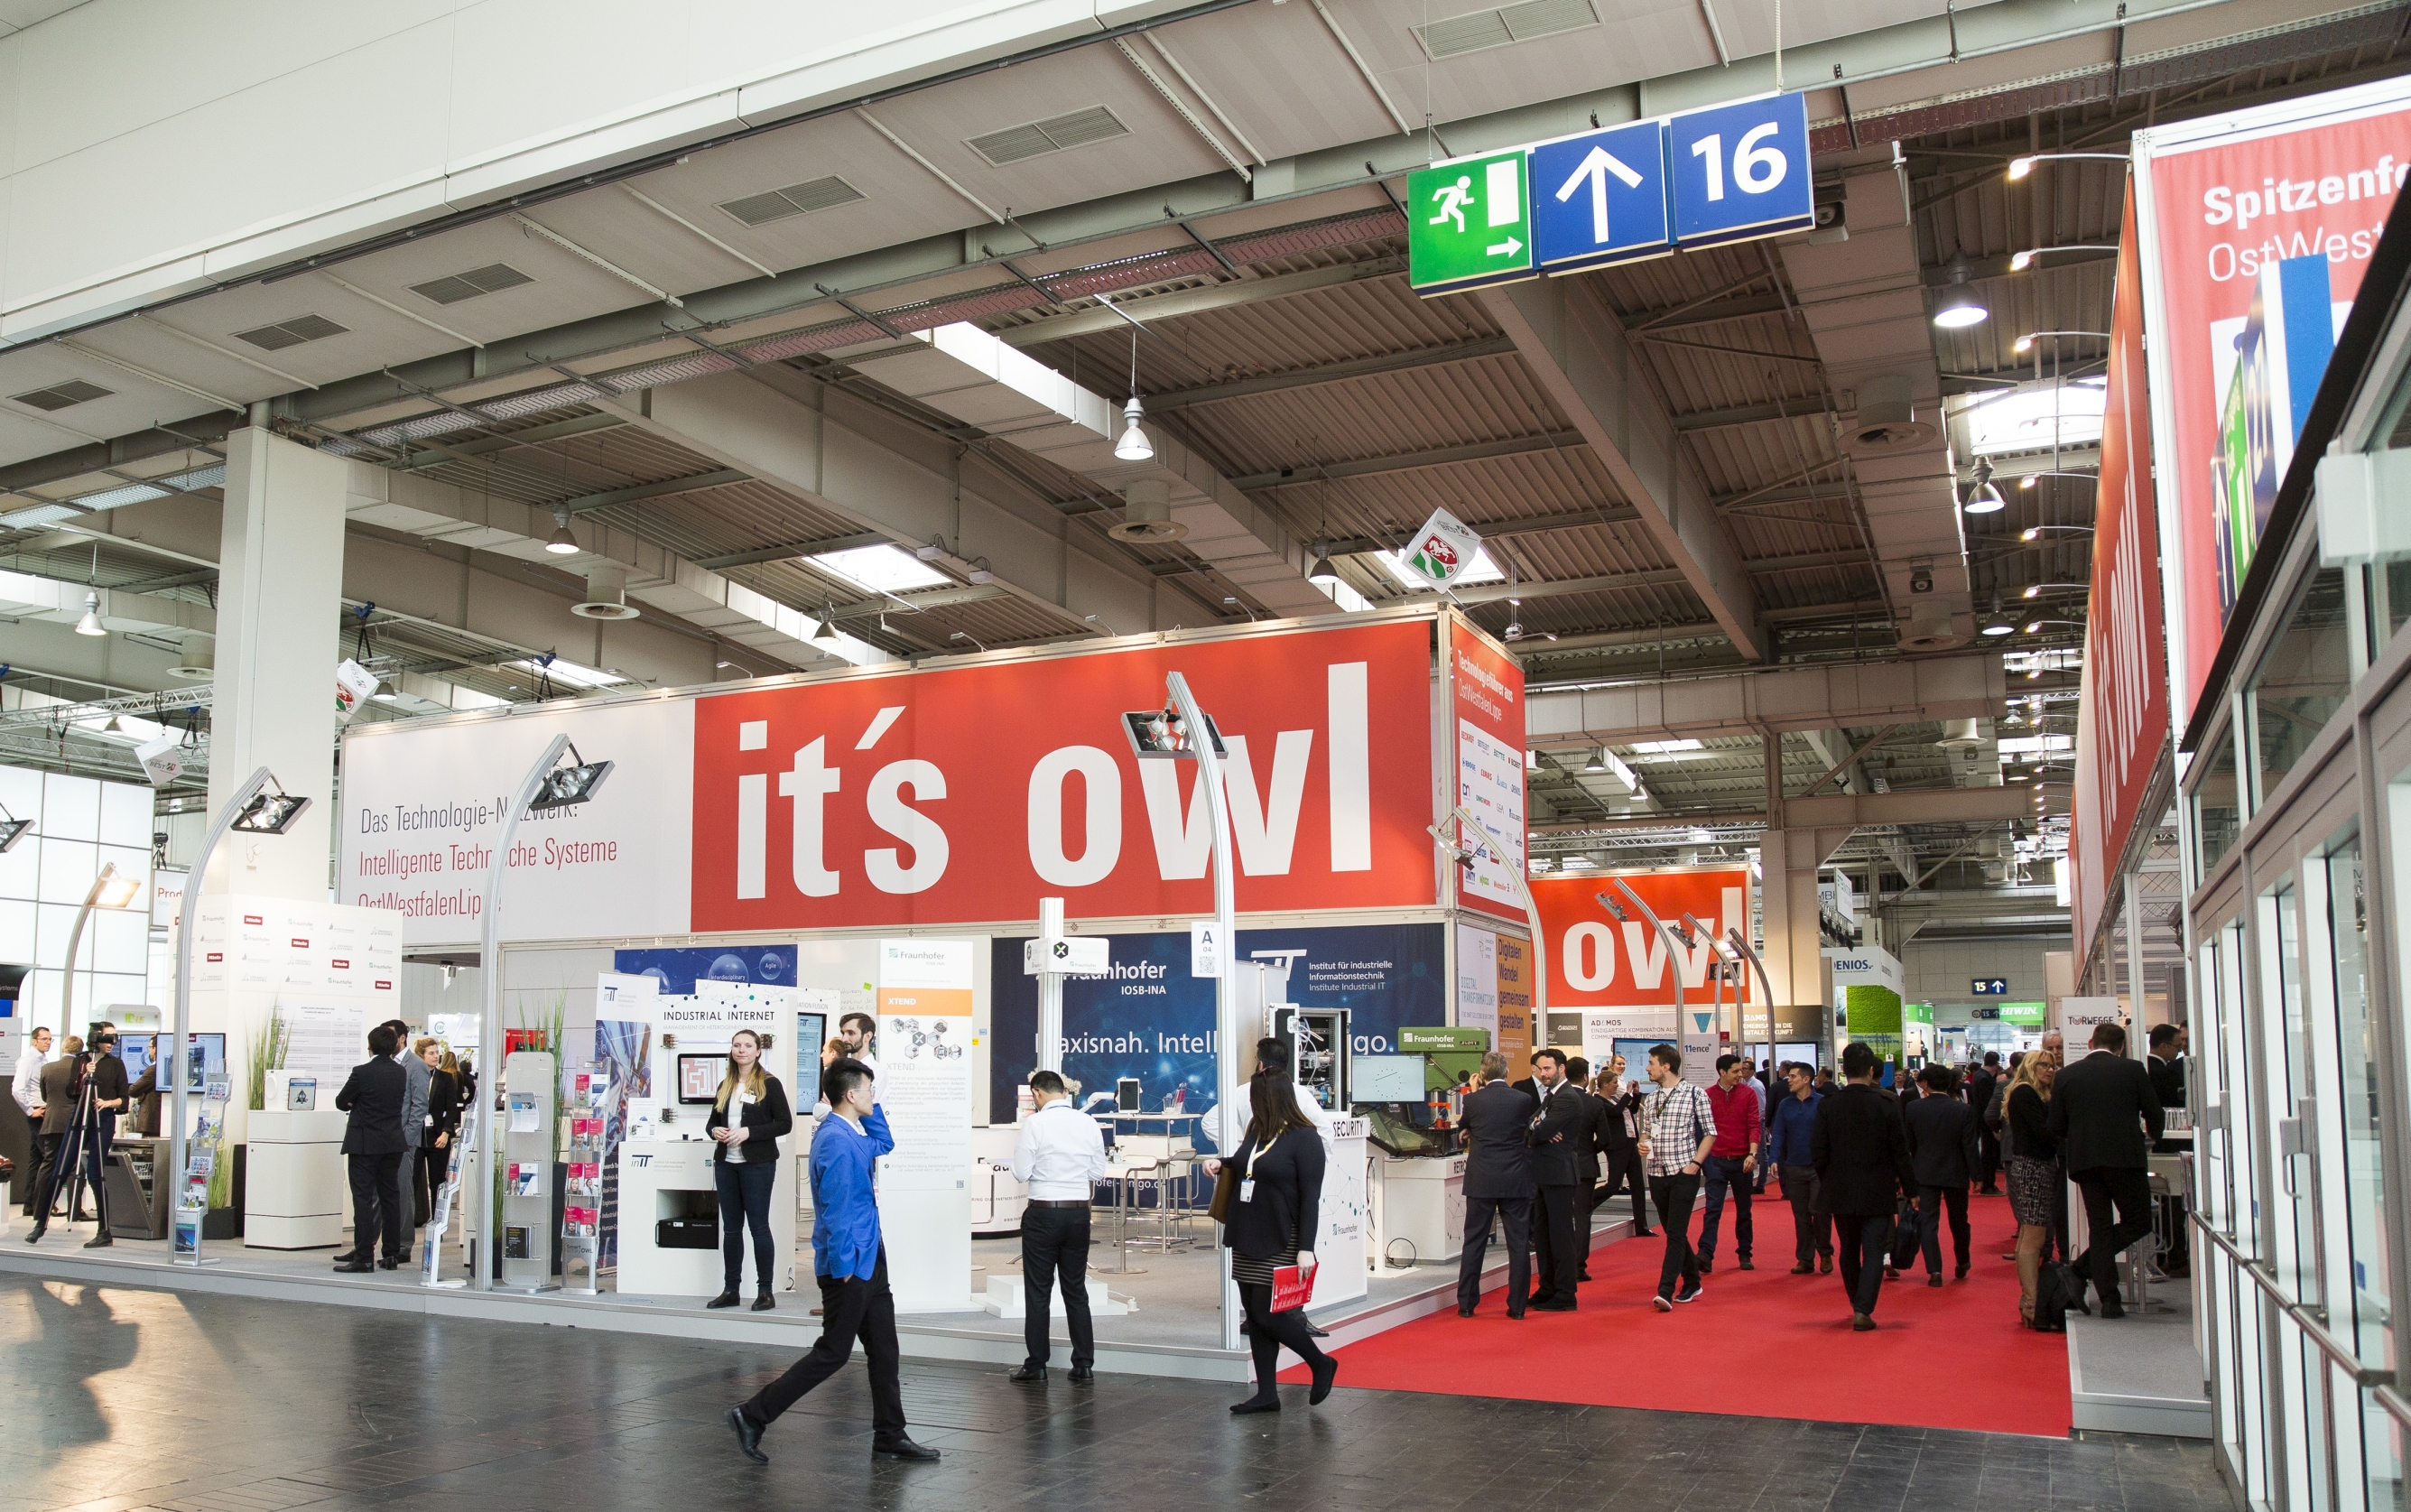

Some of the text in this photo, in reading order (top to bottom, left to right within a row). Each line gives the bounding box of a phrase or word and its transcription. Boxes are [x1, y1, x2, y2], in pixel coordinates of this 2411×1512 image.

[1691, 121, 1787, 202] 16
[1458, 649, 1514, 703] Technologieführer aus
[1459, 678, 1502, 722] OstWestfalenLippe
[1493, 748, 1506, 761] BETTE
[1027, 662, 1371, 886] owl
[361, 796, 578, 834] Das Technologie-Nzwerk:
[359, 838, 617, 880] Intelligente Techche Systeme
[1201, 931, 1213, 944] A
[1563, 886, 1746, 992] owl
[900, 951, 945, 960] Fraunhofer
[1498, 938, 1522, 961] Digitalen
[765, 961, 777, 970] Agile
[1309, 960, 1393, 970] Institut für industrielle
[1309, 971, 1385, 981] Informationstechnik
[1498, 962, 1518, 982] Wandel
[1309, 982, 1340, 991] Institute
[1341, 982, 1376, 990] Industrial
[1461, 976, 1478, 990] DIGITAL
[1974, 981, 1987, 992] 15
[603, 986, 618, 1002] inIT
[1121, 986, 1166, 995] IOSB-INA
[888, 997, 916, 1006] XTEND
[663, 1011, 774, 1021] INDUSTRIAL INTERNET
[1499, 1012, 1524, 1032] gestalten
[1034, 1031, 1149, 1053] axisnah.
[1414, 1034, 1455, 1043] Fraunhofer
[886, 1062, 915, 1071] XTEND
[1332, 1119, 1364, 1137] SECURITY
[630, 1155, 654, 1168] inIT
[1338, 1224, 1359, 1236] Fraunhofer
